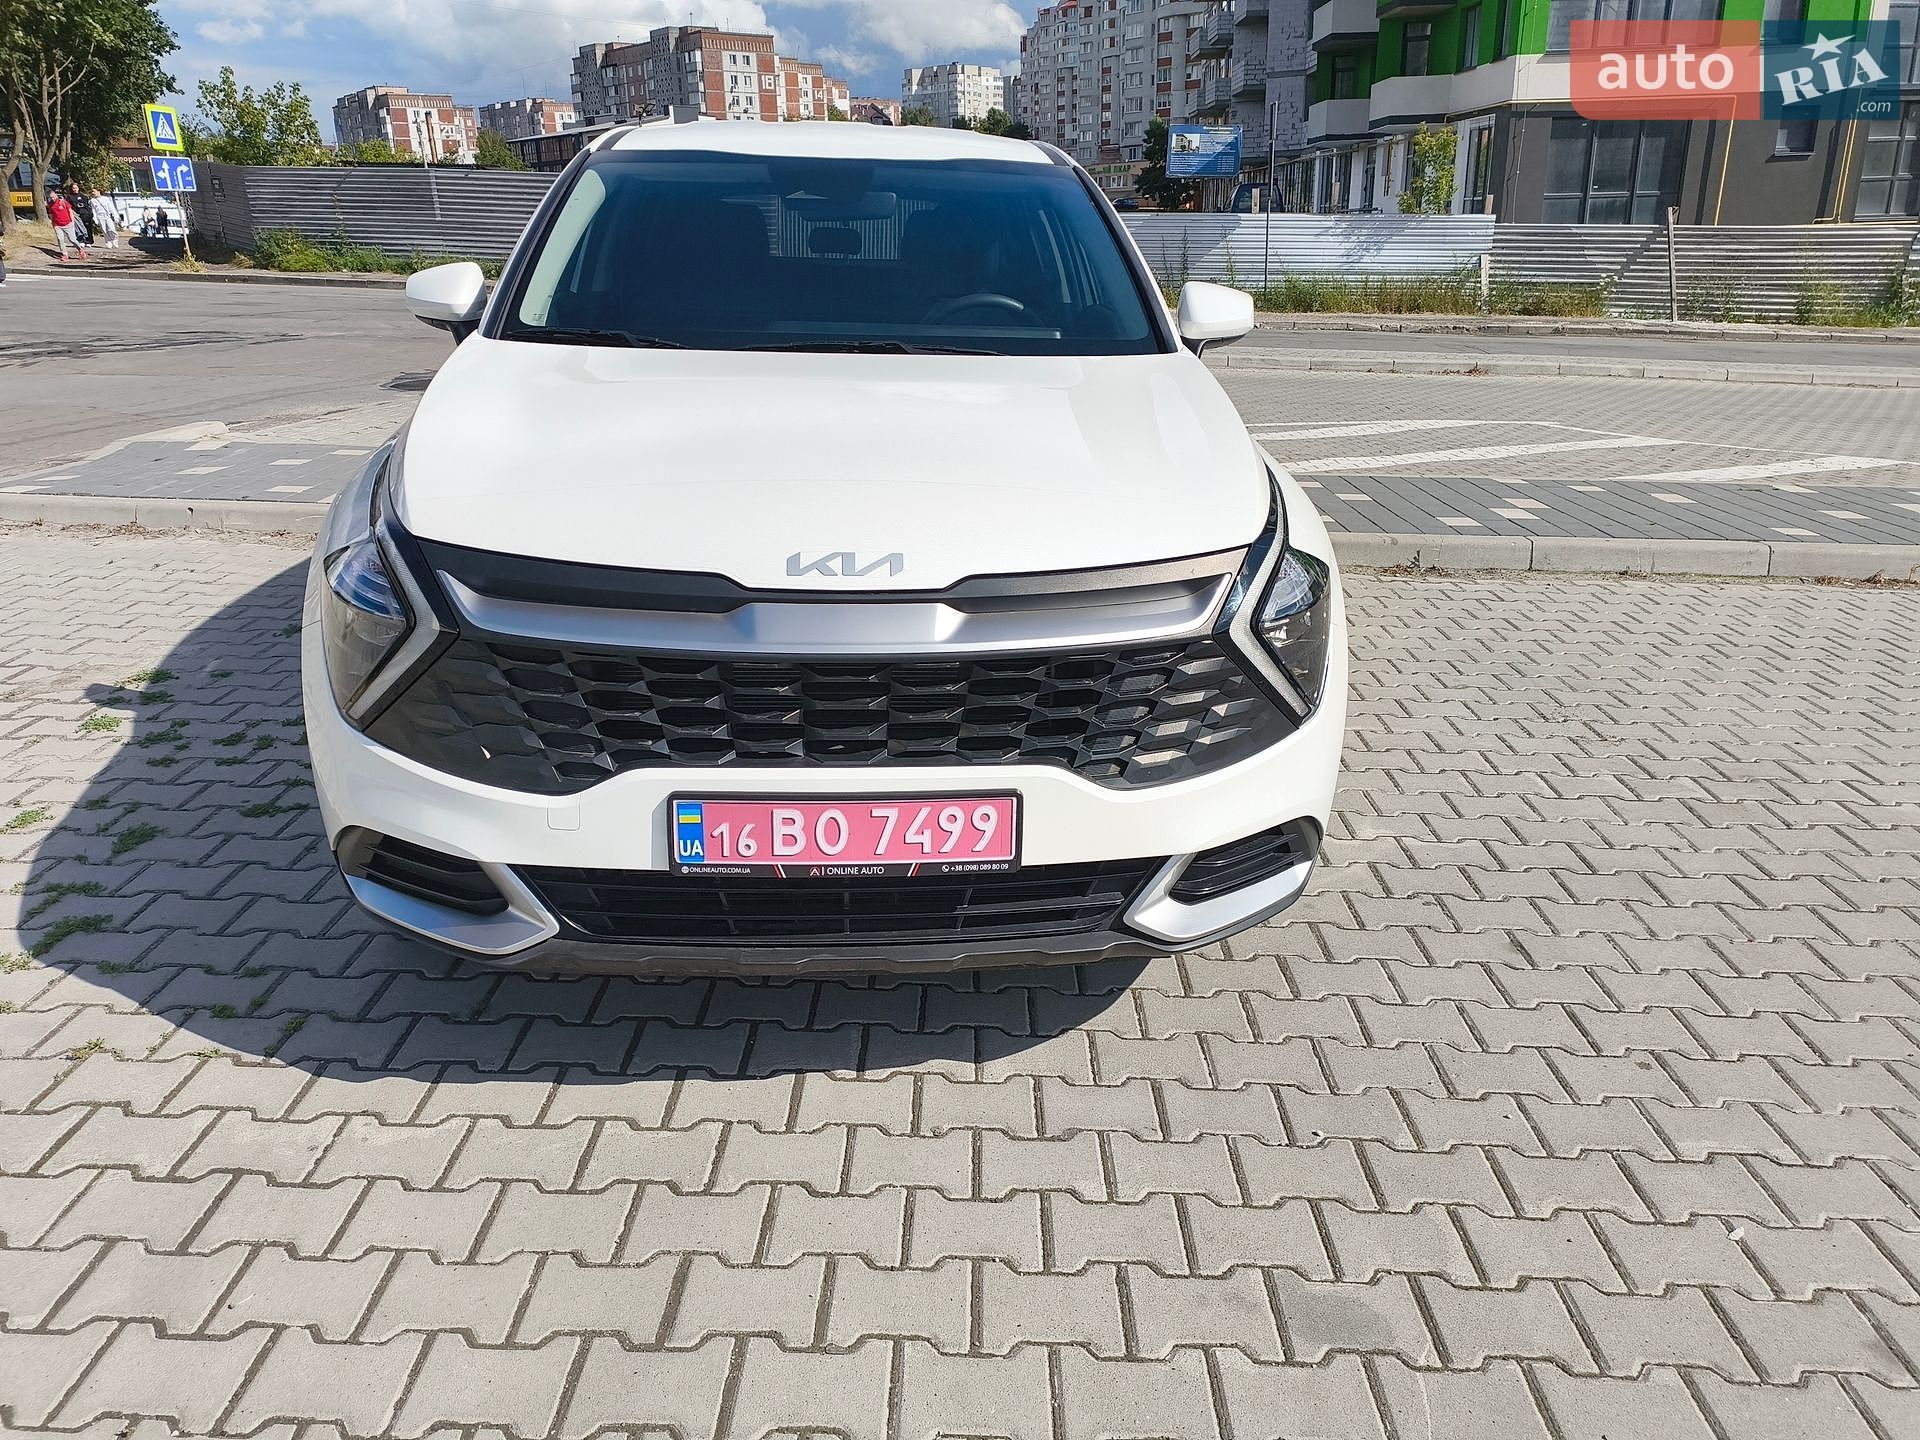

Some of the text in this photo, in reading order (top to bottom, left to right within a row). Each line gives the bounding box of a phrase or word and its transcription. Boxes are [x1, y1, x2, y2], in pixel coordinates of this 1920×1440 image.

[710, 805, 999, 857] 16 BO 7499
[679, 839, 704, 856] UA
[689, 867, 751, 875] ONLINEAUTO.COM.UA
[826, 866, 885, 875] ONLINE AUTO
